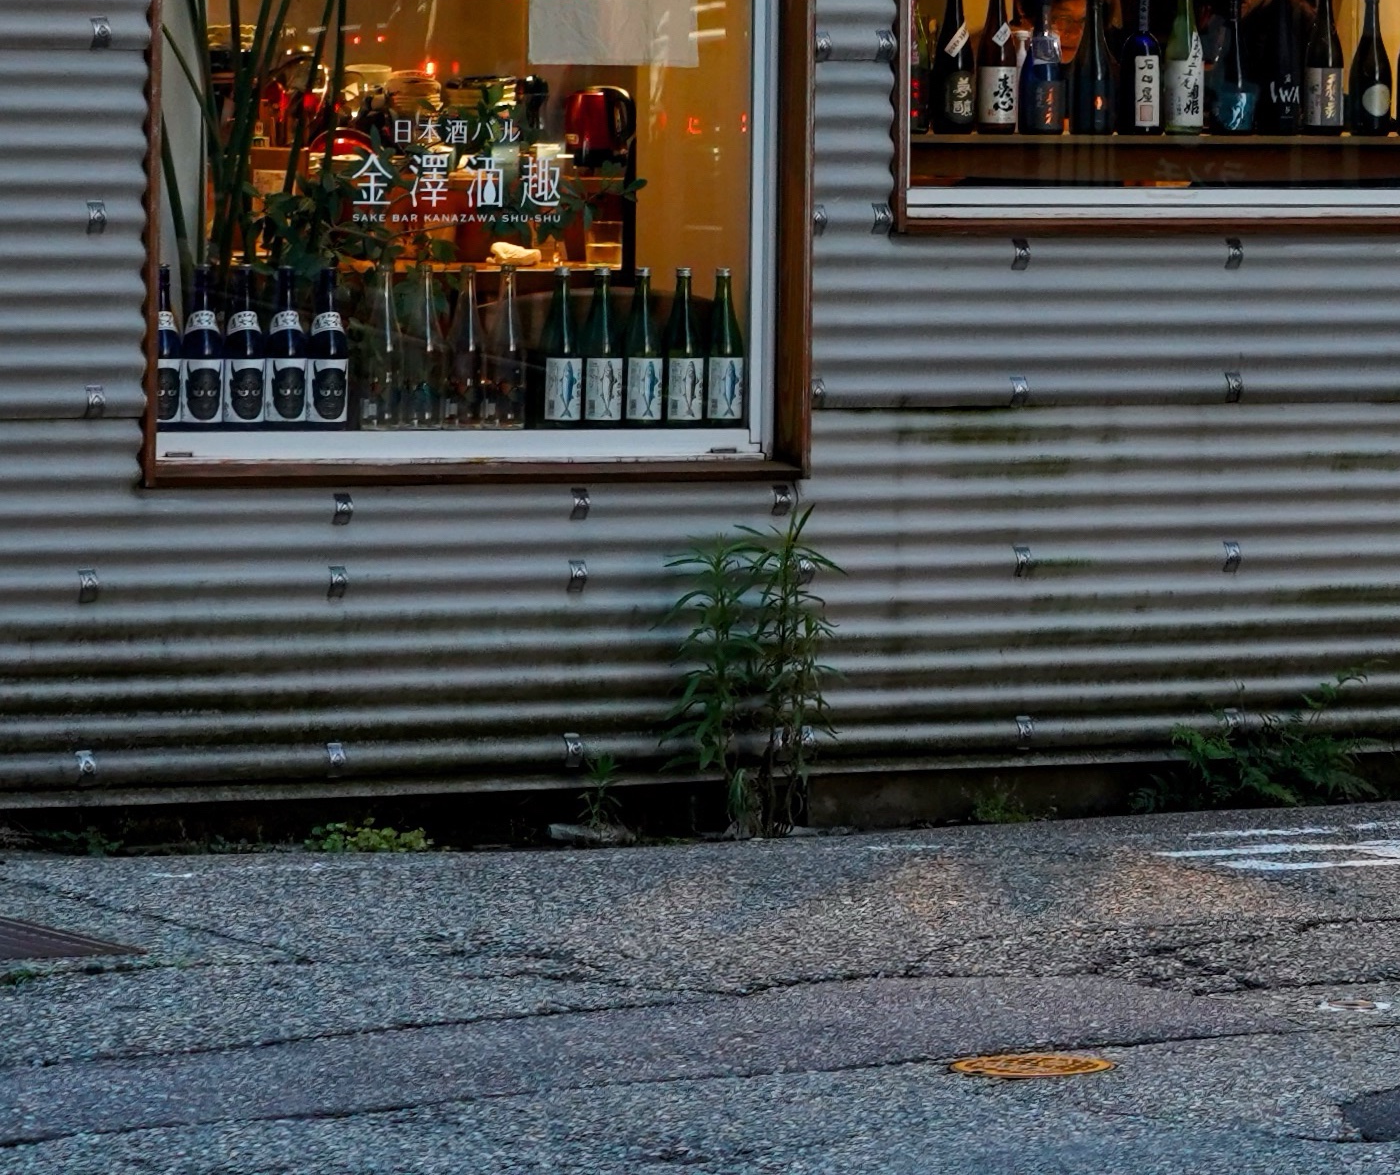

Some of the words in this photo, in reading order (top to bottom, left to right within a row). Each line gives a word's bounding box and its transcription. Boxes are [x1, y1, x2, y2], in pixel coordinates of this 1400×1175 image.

[1269, 80, 1300, 105] IWA
[393, 118, 521, 144] 日本酒バル
[352, 153, 561, 208] 金澤酒趣
[352, 214, 386, 223] SAKE
[392, 214, 418, 223] BAR
[424, 214, 496, 223] KANAZAWA
[502, 214, 561, 223] SHU-SHU
